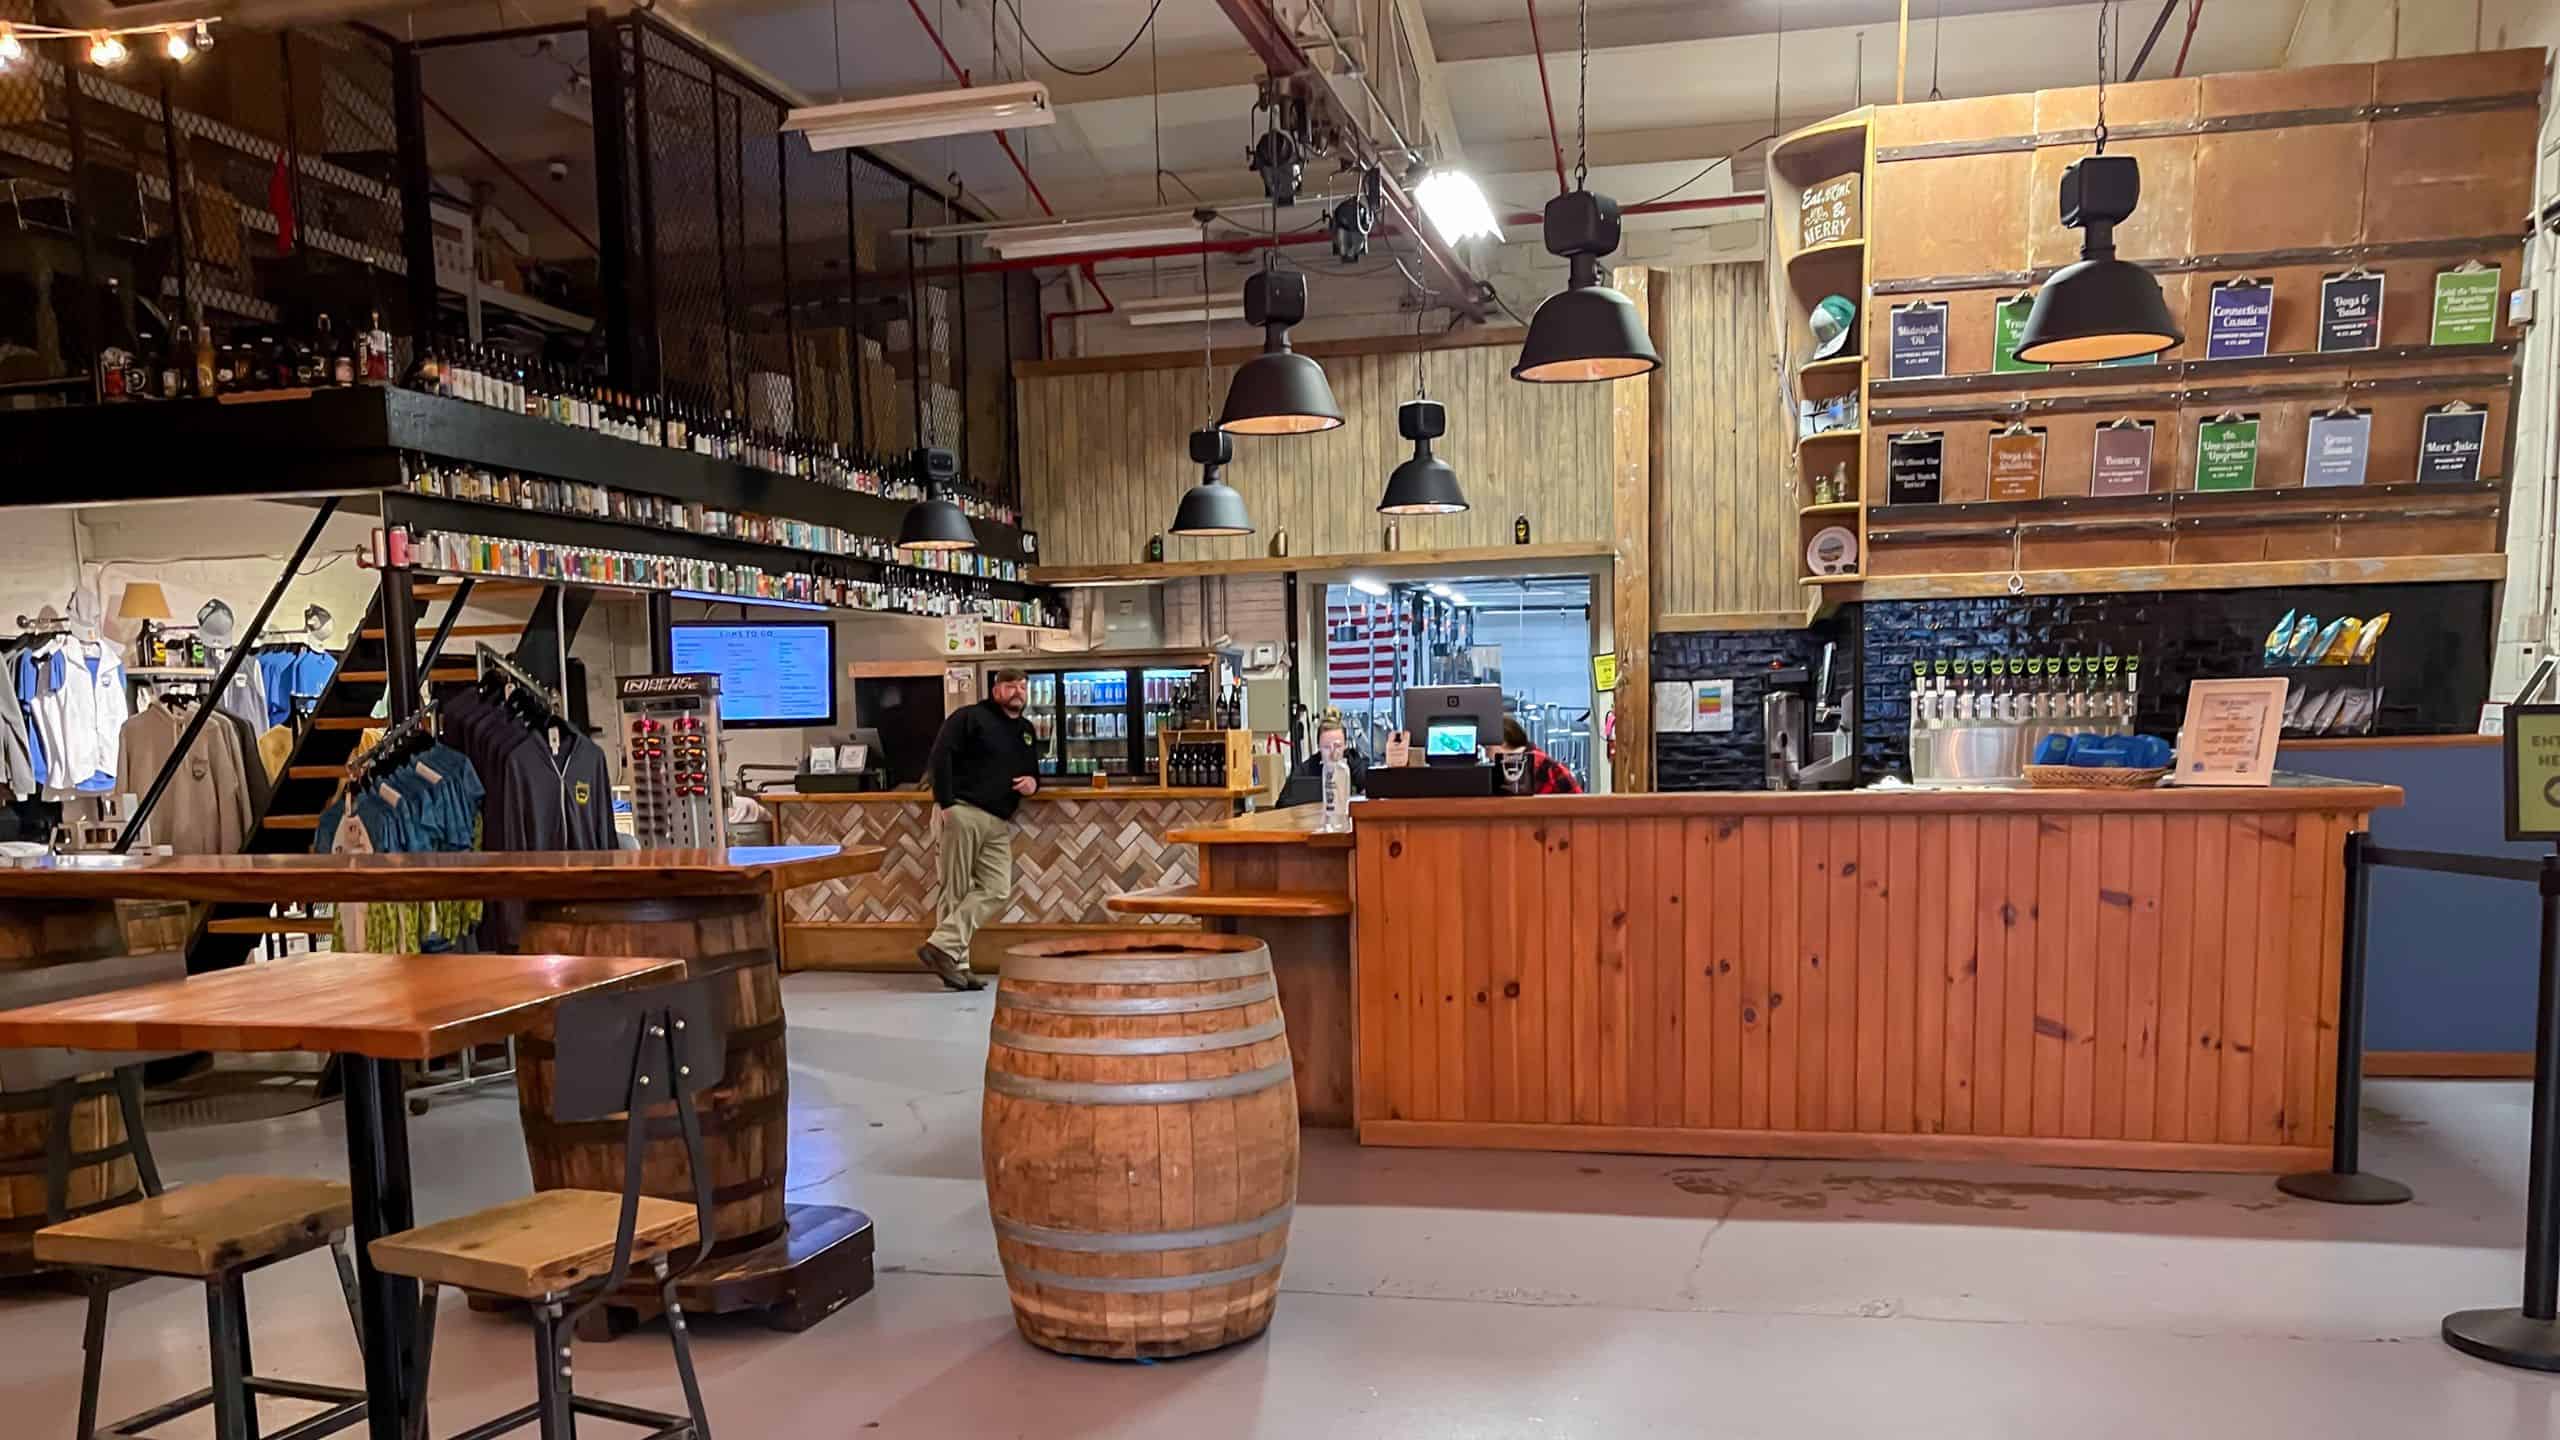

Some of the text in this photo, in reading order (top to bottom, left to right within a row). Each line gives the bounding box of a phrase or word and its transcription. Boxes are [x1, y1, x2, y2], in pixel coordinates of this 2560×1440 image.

[1803, 217, 1851, 247] MERRY
[2214, 304, 2269, 317] Connecticut
[1897, 323, 1939, 337] Midnight
[2426, 441, 2452, 452] More
